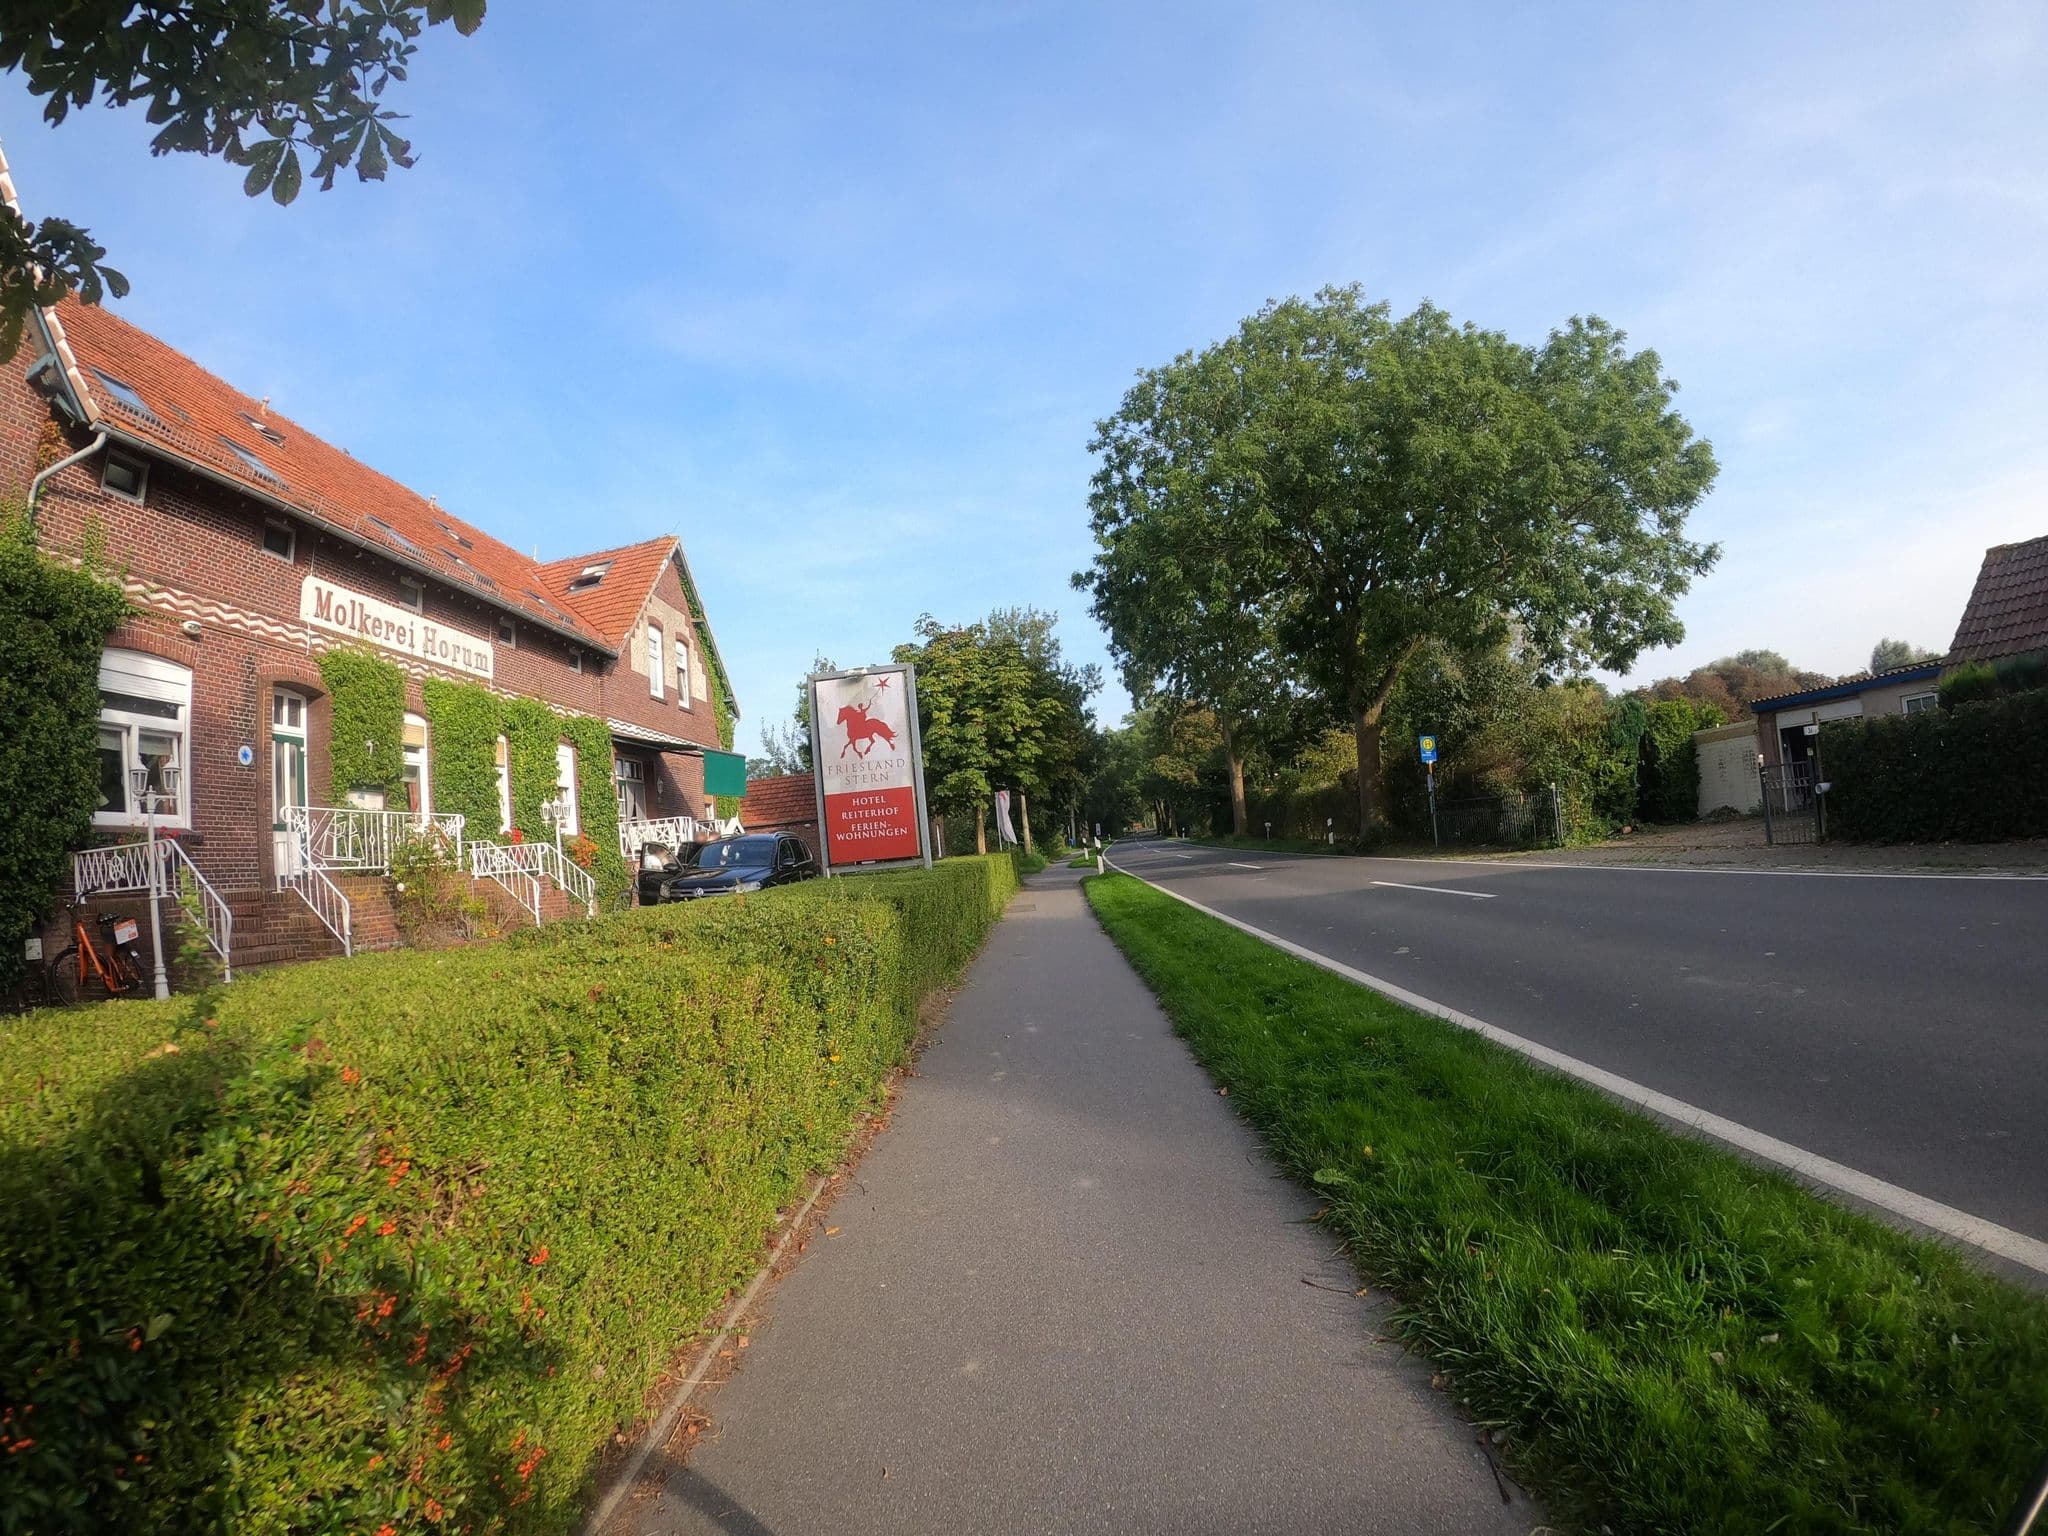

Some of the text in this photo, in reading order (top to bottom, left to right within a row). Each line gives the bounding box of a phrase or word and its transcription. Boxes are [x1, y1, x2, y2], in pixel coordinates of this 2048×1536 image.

[314, 586, 490, 673] Molkerei Horum
[828, 758, 906, 775] FRIESLAND
[845, 772, 889, 785] STERN
[852, 795, 887, 806] HOTEL
[841, 806, 899, 820] REITERHOF
[851, 820, 891, 832] FERIEN-
[836, 827, 908, 841] WOHNUNGEN
